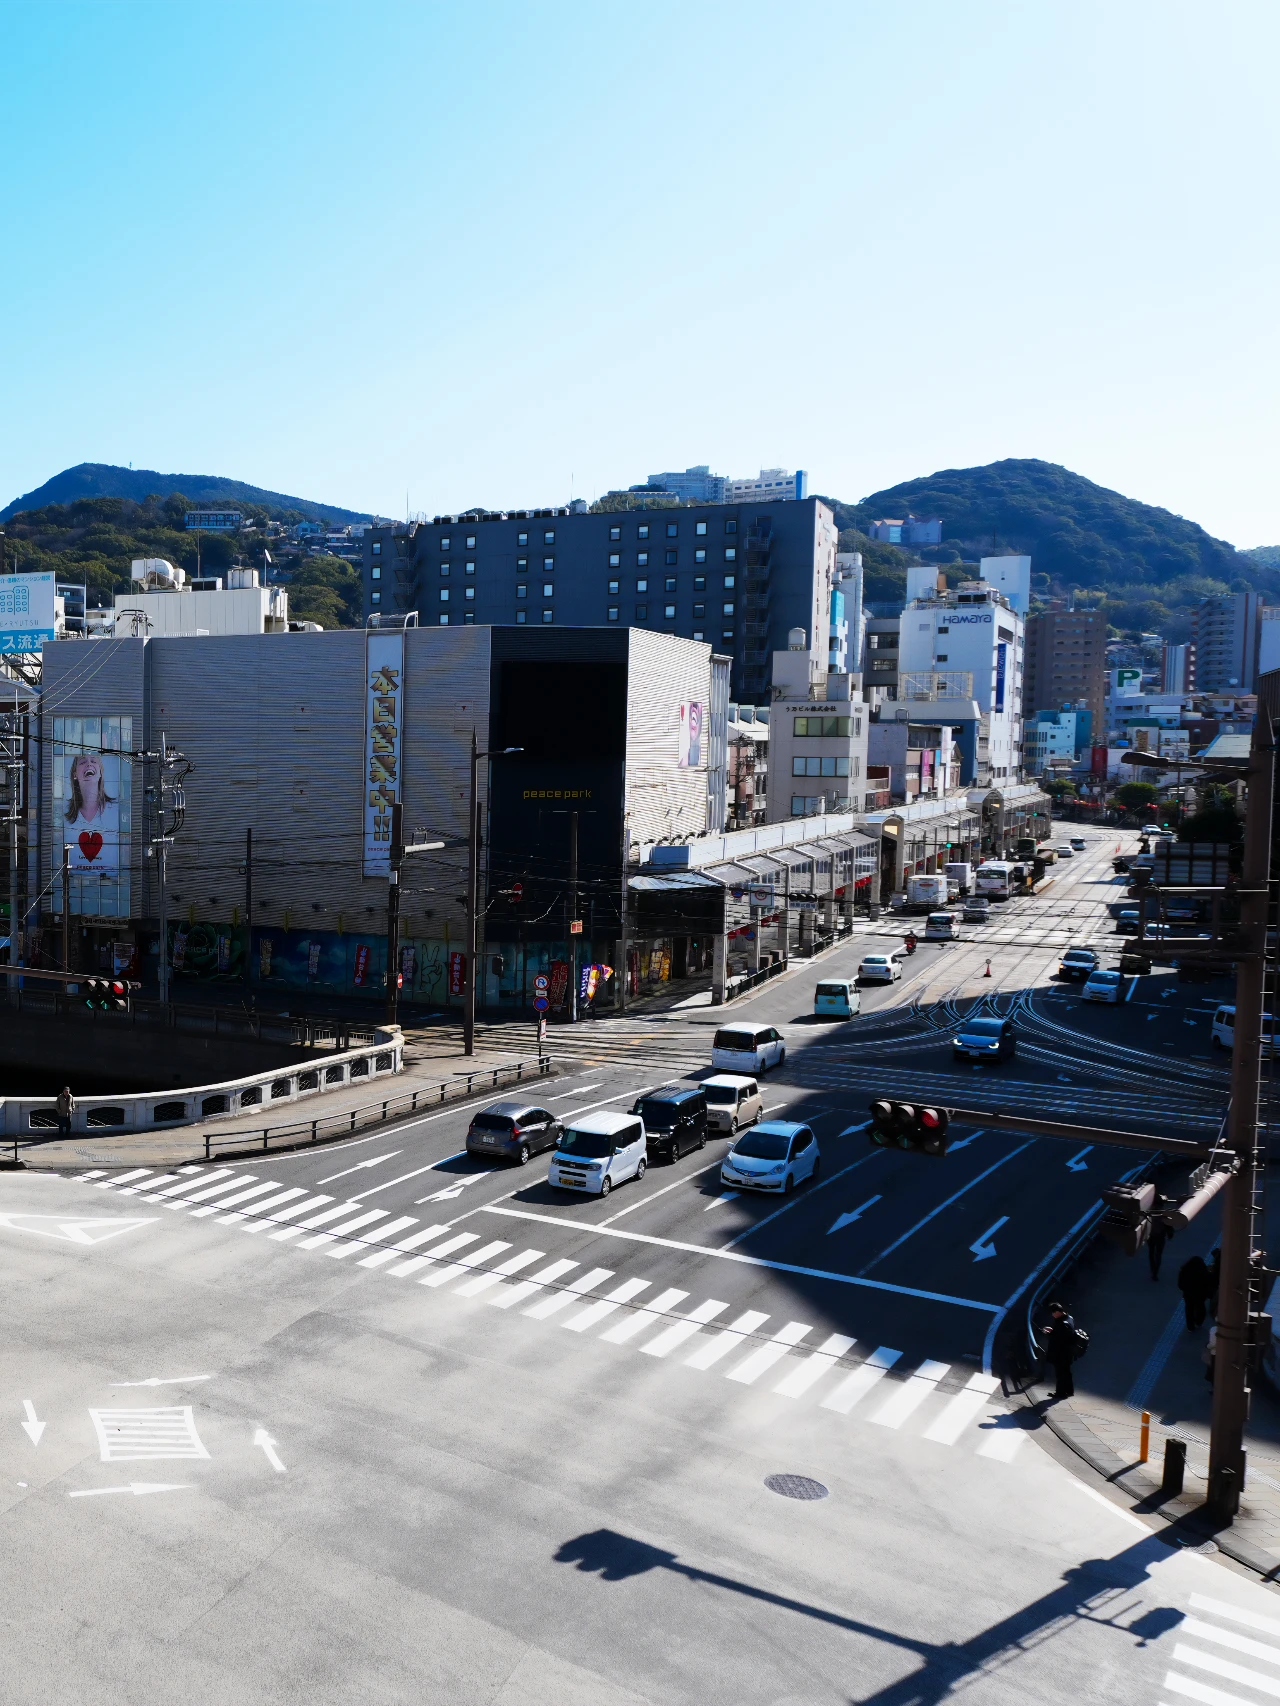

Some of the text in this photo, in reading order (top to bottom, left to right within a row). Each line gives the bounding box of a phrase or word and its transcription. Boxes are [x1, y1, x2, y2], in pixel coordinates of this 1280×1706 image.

[1117, 669, 1141, 688] P
[523, 789, 592, 800] peace park
